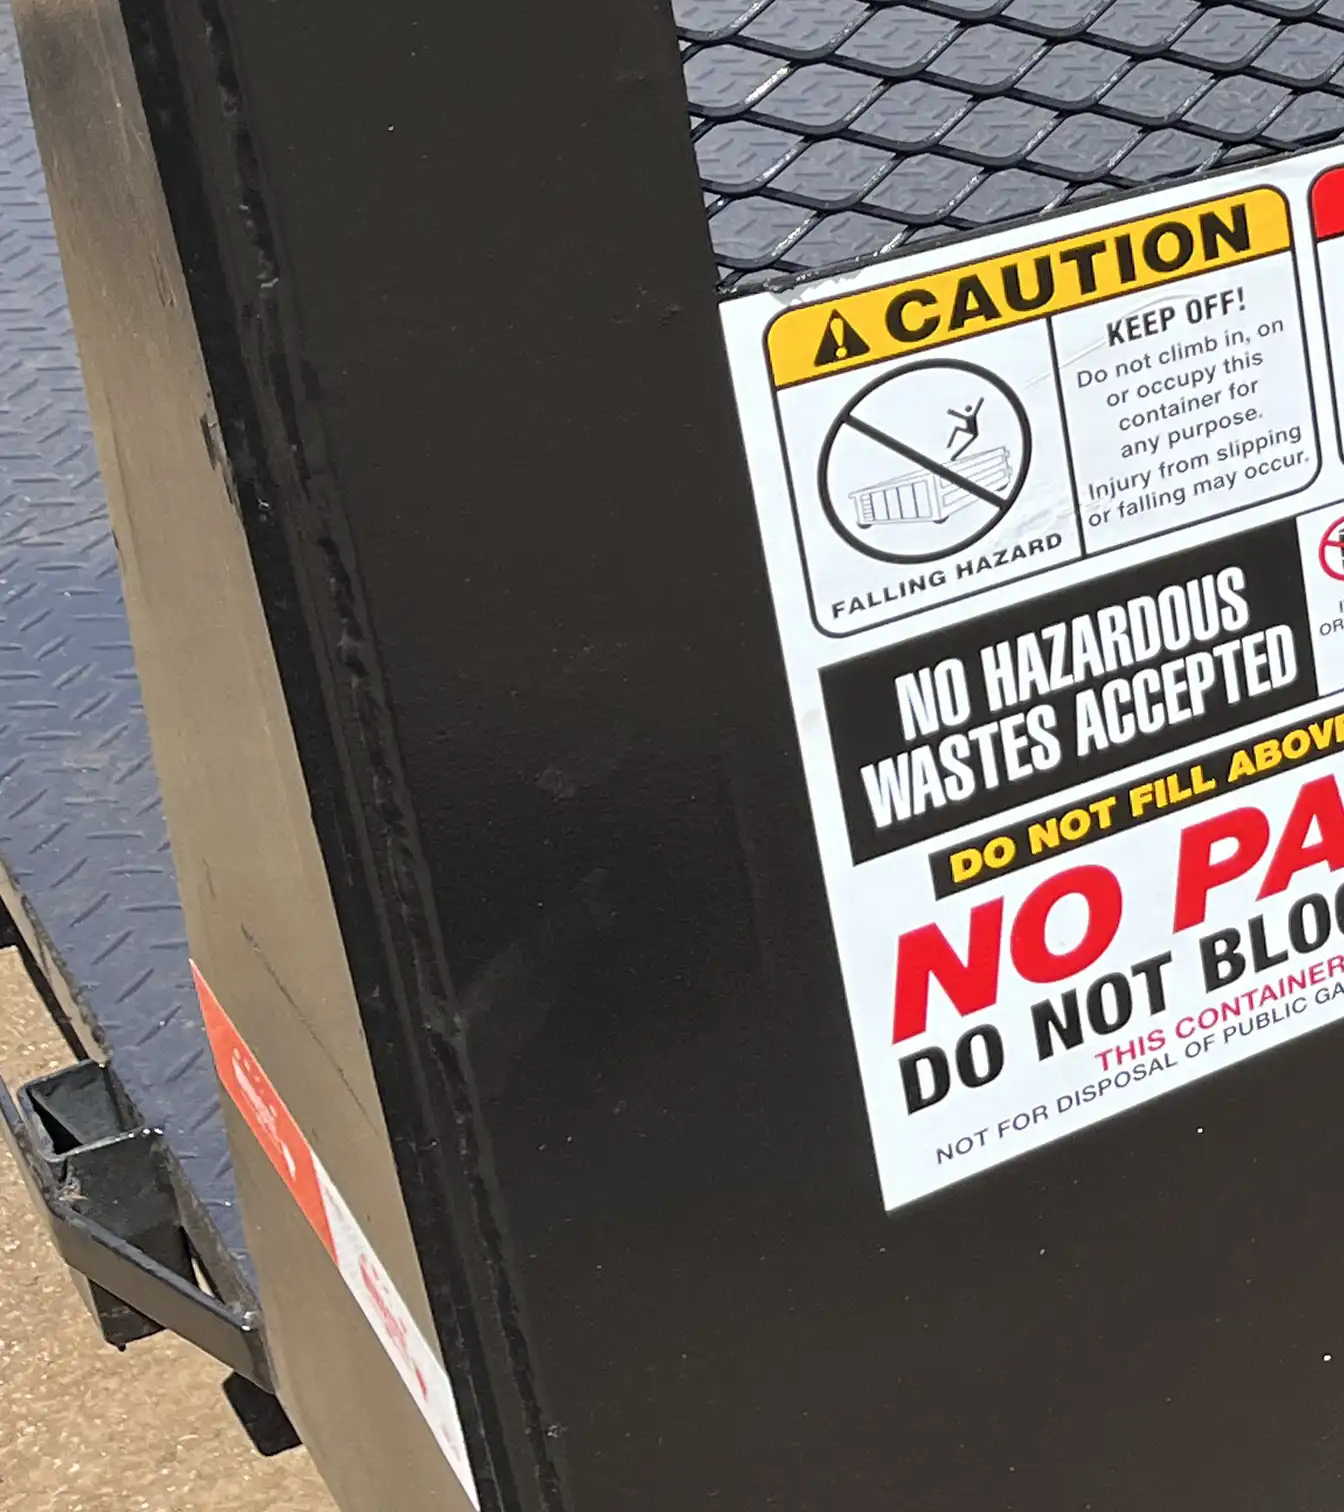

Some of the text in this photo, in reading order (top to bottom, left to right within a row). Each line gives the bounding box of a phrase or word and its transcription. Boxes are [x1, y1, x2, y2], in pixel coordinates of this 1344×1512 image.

[885, 203, 1251, 343] CAUTION
[1076, 319, 1284, 389] Do not climb in, on
[1106, 286, 1246, 347] KEEP OFF!
[1106, 351, 1264, 408] or occupy this
[1118, 379, 1259, 432] container for
[1088, 425, 1302, 501] Injury from slipping
[1121, 408, 1263, 459] any purpose.
[1088, 450, 1309, 527] or falling may occur.
[831, 532, 1062, 620] FALLING HAZARD
[894, 566, 1249, 741] NO HAZARDOUS
[1319, 617, 1344, 637] OR
[860, 624, 1298, 829] WASTES ACCEPTED
[949, 836, 1016, 883] DO
[1028, 796, 1117, 855] NOT
[1129, 765, 1217, 817] FILL
[892, 864, 1123, 1045] NO
[898, 1023, 1005, 1116] DO
[1030, 950, 1173, 1062] NOT
[1094, 1028, 1166, 1072] THIS
[936, 1127, 988, 1165] NOT
[997, 1104, 1049, 1139] FOR
[1056, 1052, 1179, 1114] DISPOSAL
[1184, 1033, 1215, 1059] OF
[1222, 996, 1308, 1044] PUBLIC
